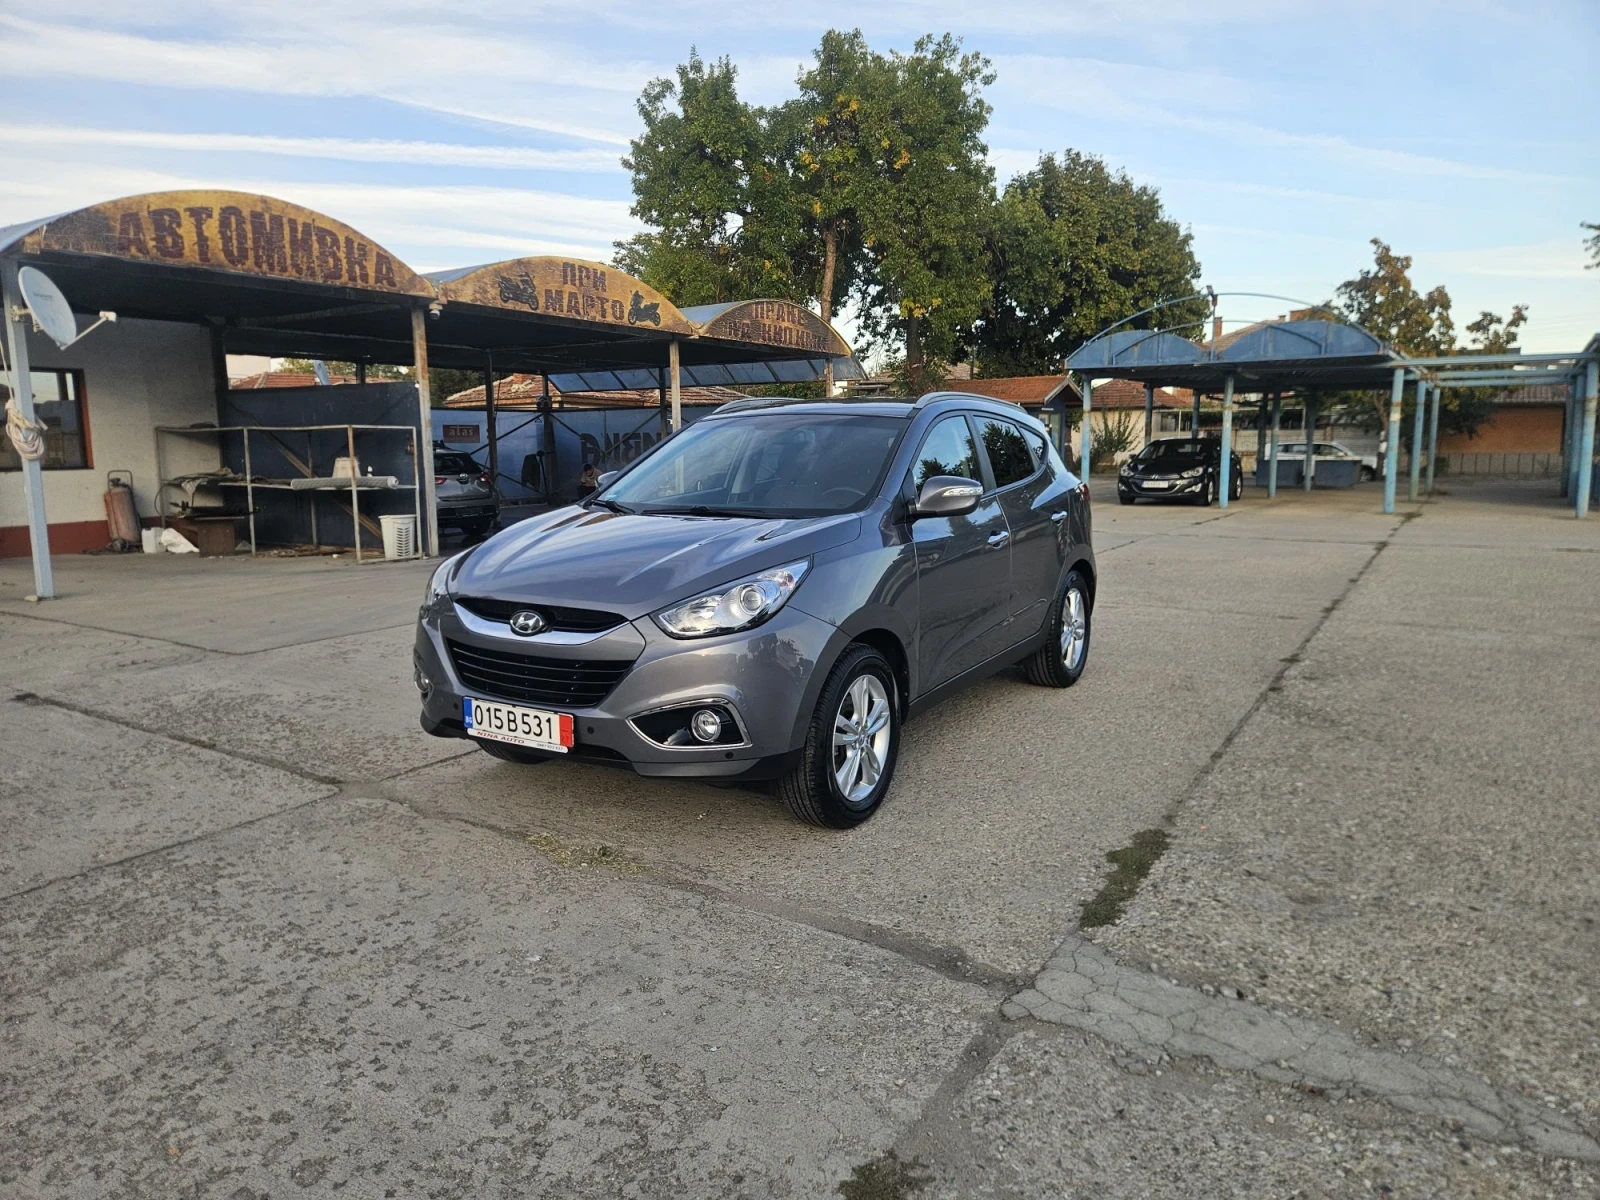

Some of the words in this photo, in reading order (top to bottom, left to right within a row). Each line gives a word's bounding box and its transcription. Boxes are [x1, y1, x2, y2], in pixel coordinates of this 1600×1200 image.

[117, 204, 398, 288] АВТОМИВКА
[562, 261, 607, 293] ПРИ
[544, 288, 625, 321] МАРТО
[476, 731, 499, 740] NINA
[501, 736, 525, 744] AUTO
